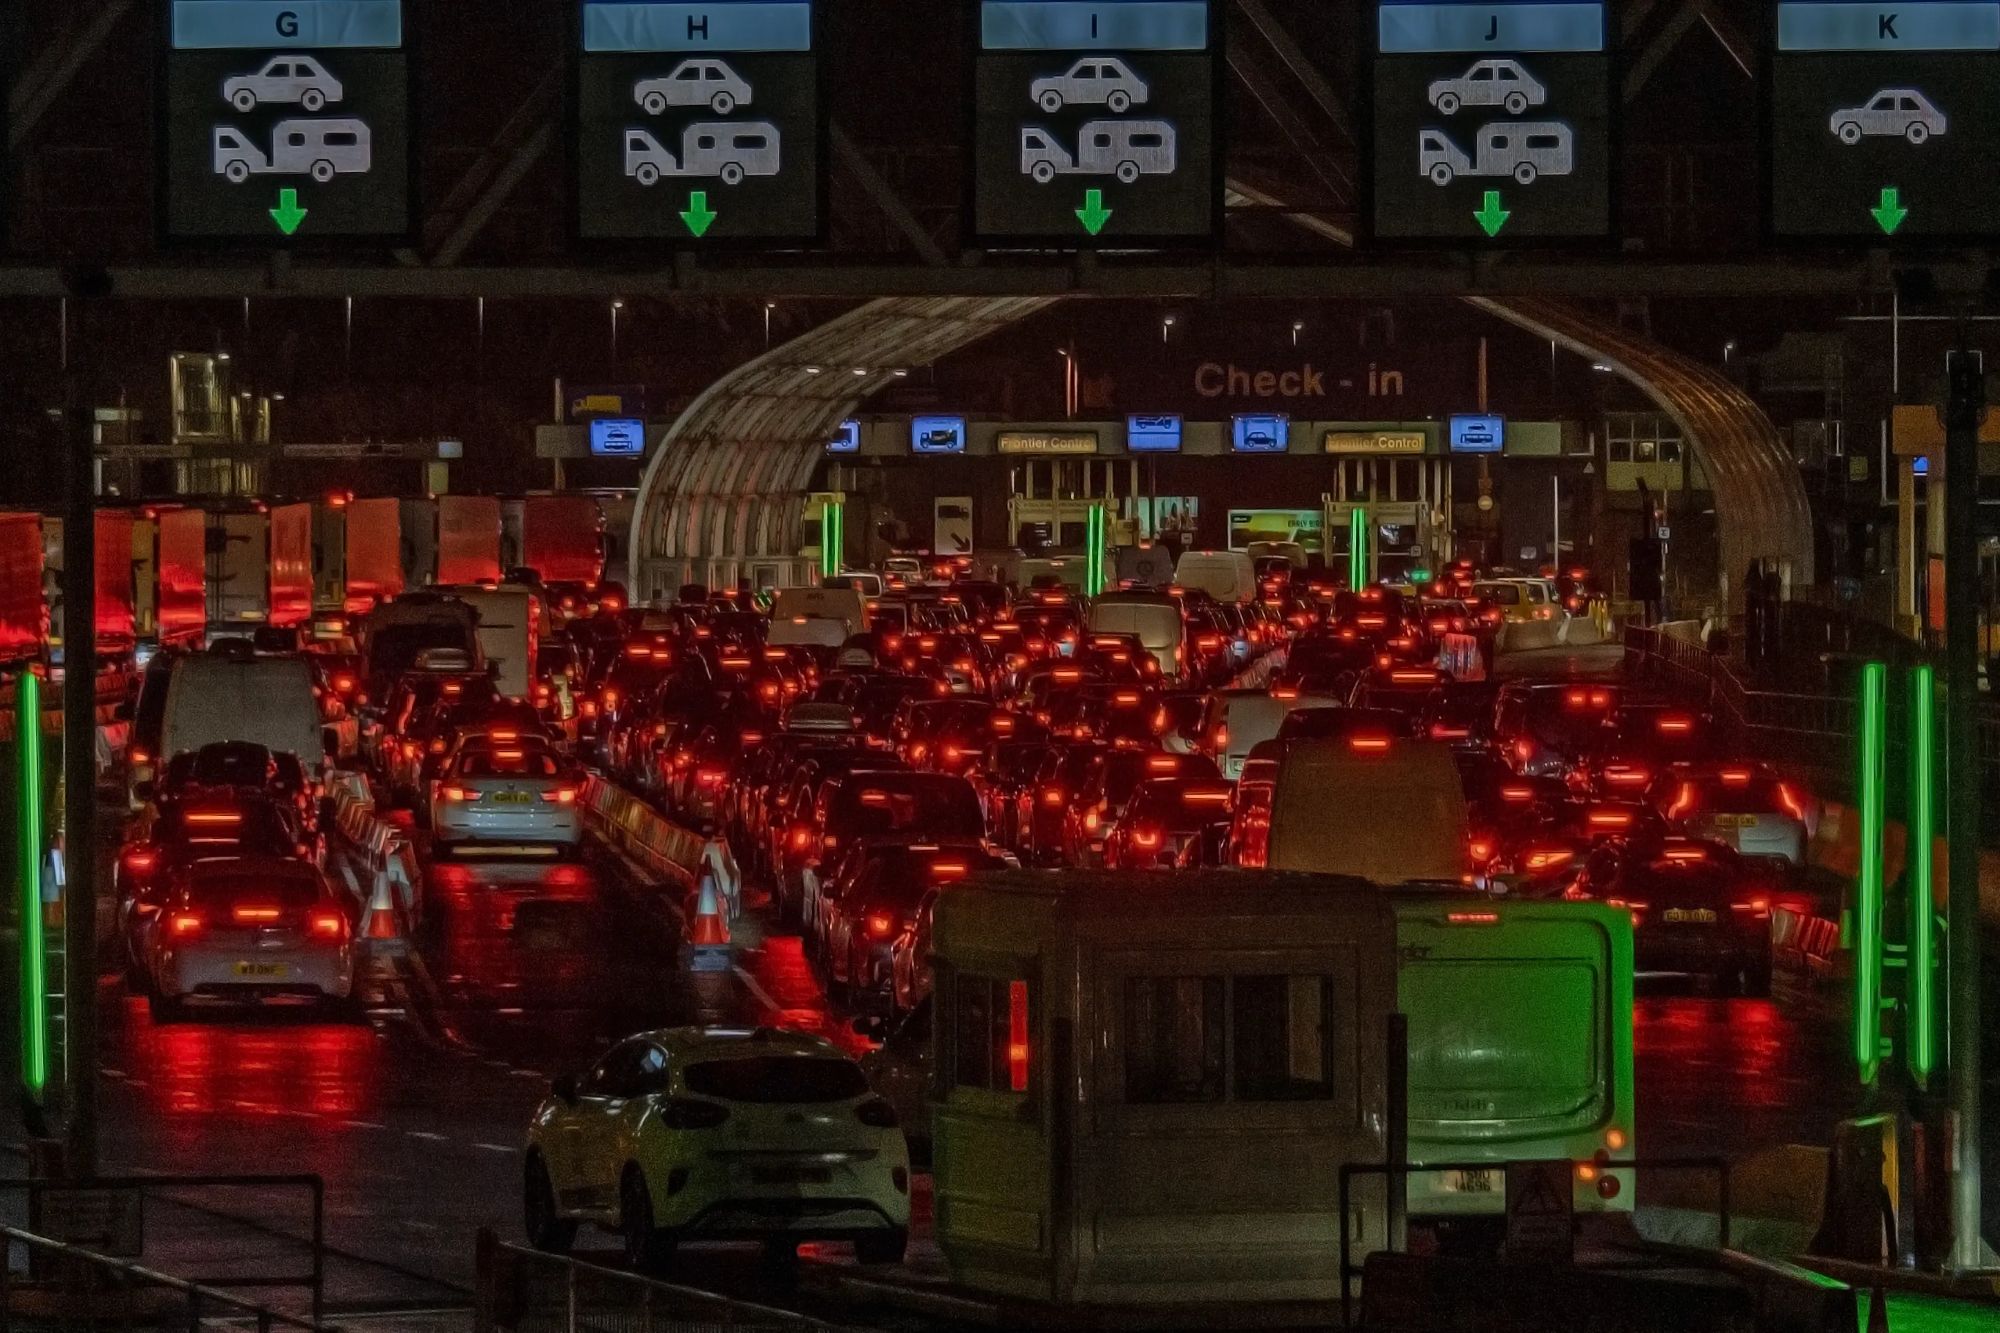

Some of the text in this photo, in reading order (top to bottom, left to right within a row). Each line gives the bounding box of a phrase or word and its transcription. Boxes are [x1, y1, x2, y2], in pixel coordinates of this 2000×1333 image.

[276, 11, 299, 38] G
[687, 16, 708, 40] H
[1091, 14, 1098, 38] I
[1484, 16, 1498, 40] J
[1878, 15, 1898, 39] K
[1194, 361, 1326, 398] Check
[1368, 361, 1404, 397] in
[1001, 437, 1048, 449] Frontier
[1328, 436, 1422, 449] Frontier Control
